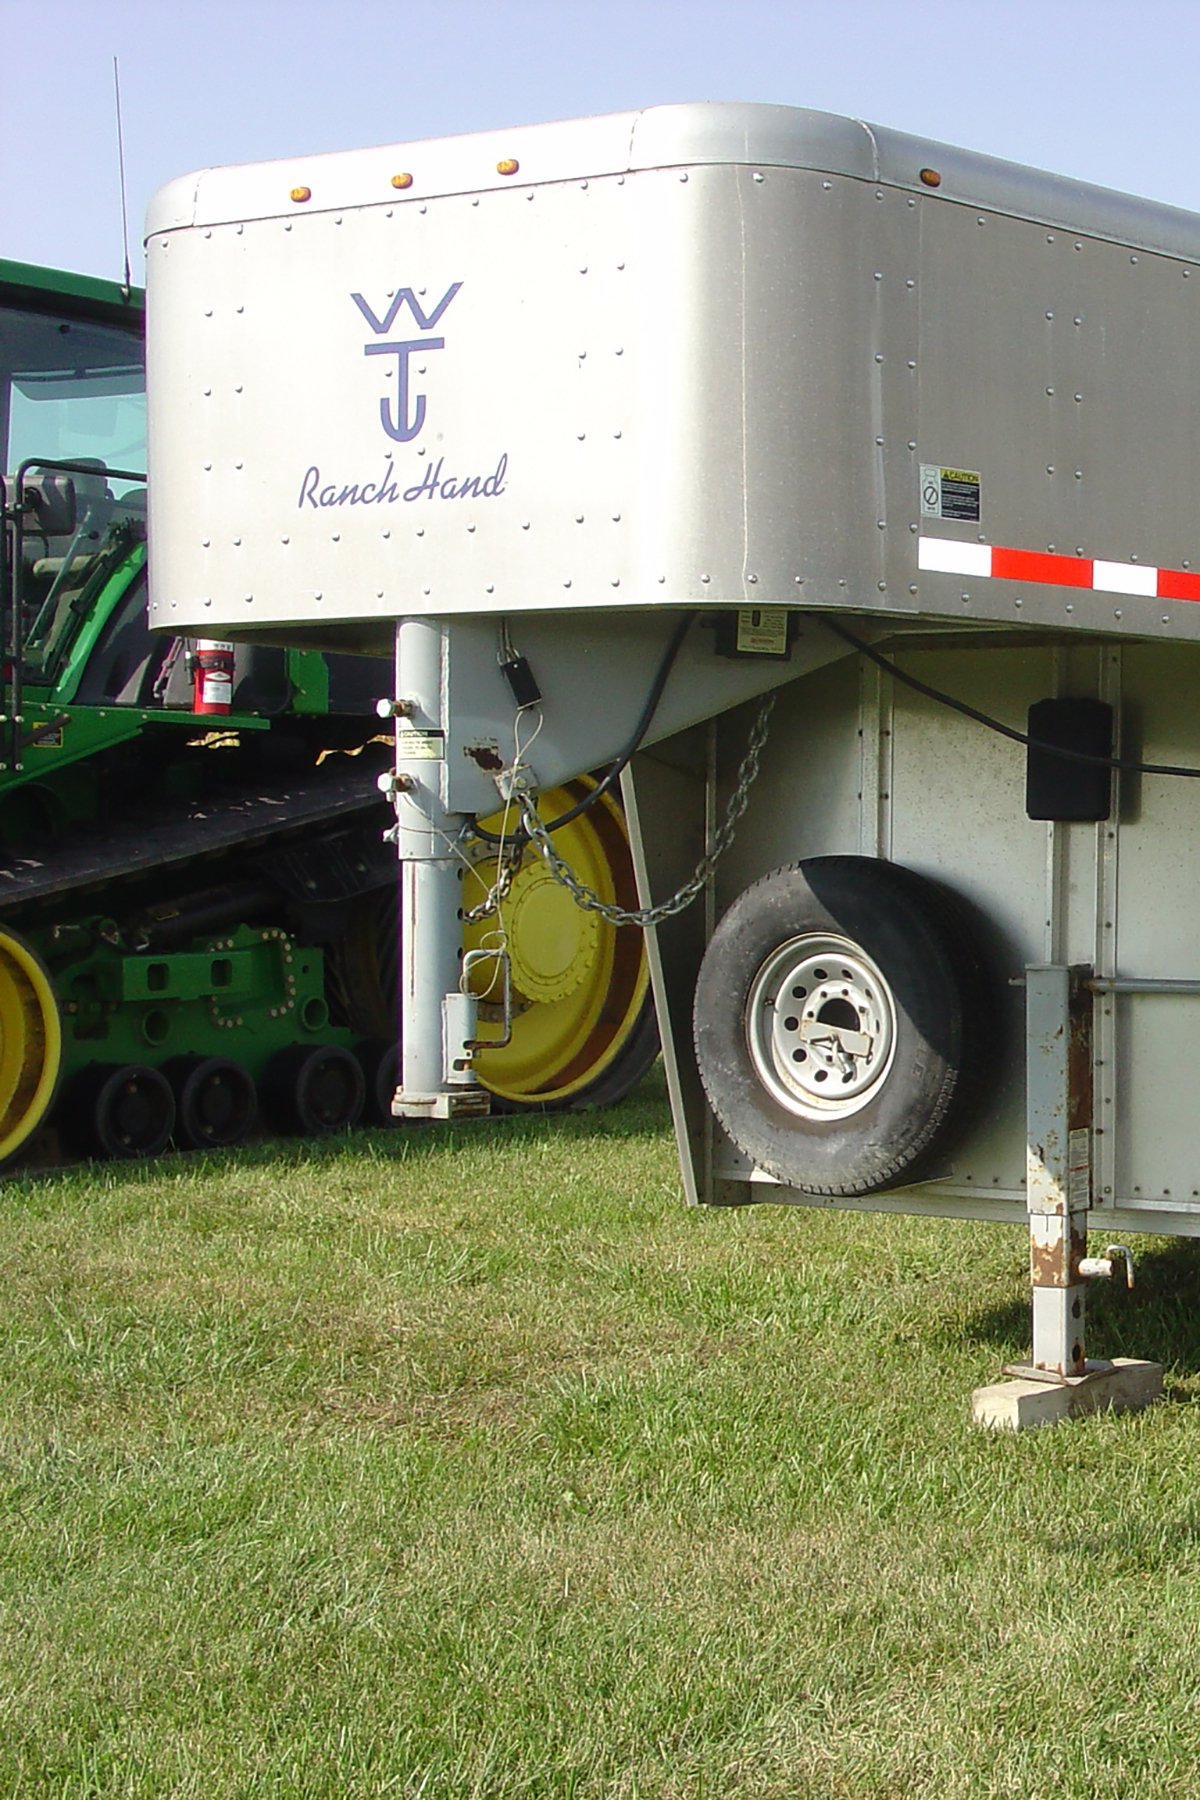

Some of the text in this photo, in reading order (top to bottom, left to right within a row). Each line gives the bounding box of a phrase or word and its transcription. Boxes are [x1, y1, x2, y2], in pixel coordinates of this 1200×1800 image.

[298, 452, 509, 509] Ranch Hand
[949, 471, 979, 482] CAUTION
